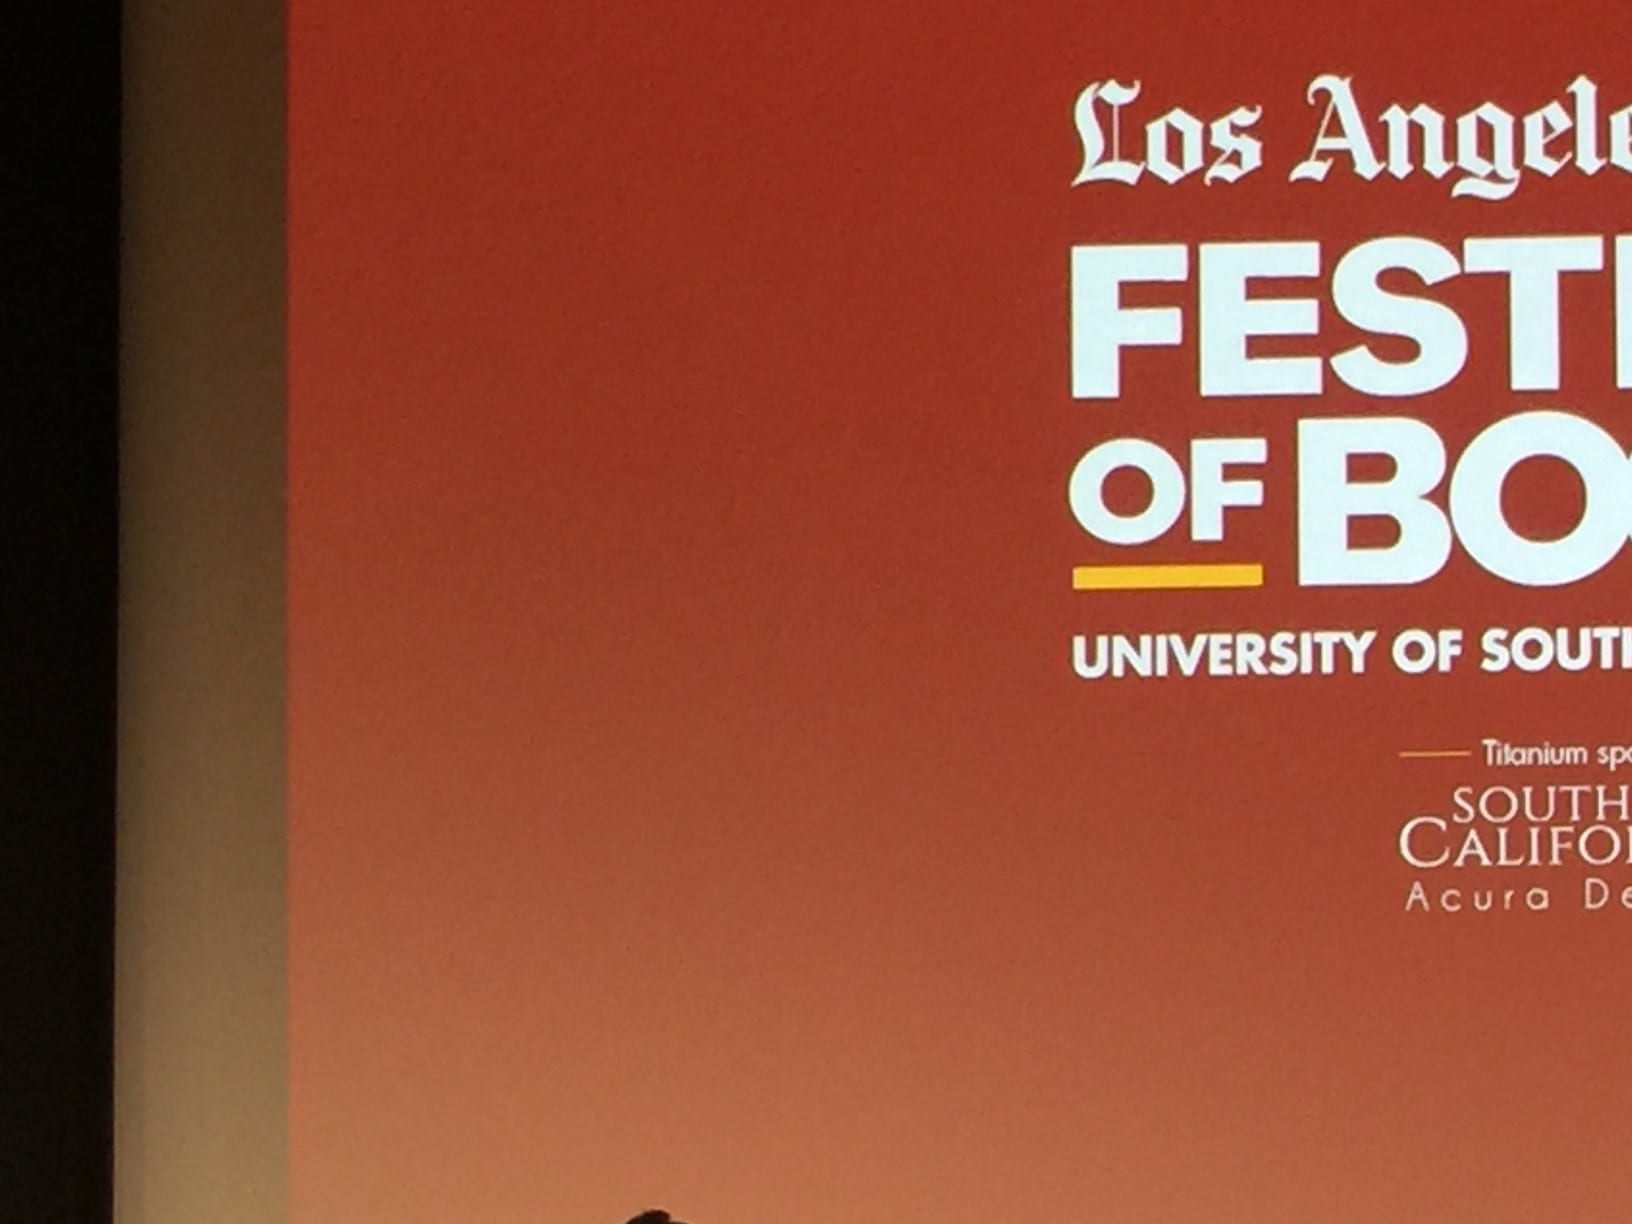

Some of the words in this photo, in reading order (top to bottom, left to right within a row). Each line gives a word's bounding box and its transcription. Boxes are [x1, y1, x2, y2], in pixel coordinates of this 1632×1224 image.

[1072, 78, 1263, 187] Los
[1068, 437, 1265, 546] OF
[1072, 630, 1376, 678] UNIVERSITY
[1391, 628, 1464, 675] OF
[1482, 738, 1587, 767] Titanium
[1405, 881, 1549, 912] Acura
